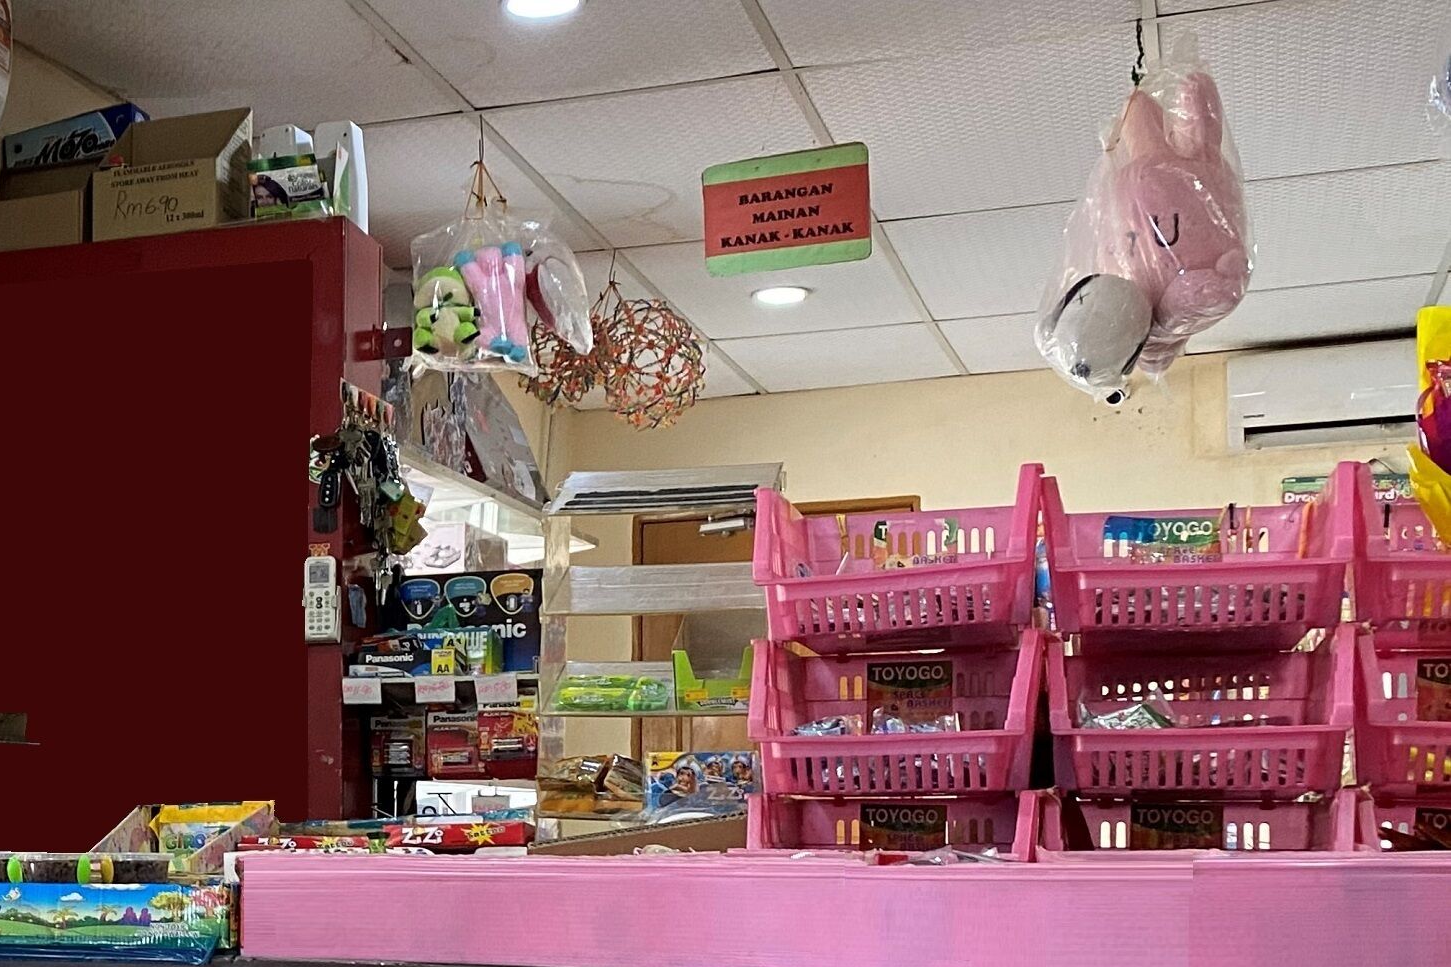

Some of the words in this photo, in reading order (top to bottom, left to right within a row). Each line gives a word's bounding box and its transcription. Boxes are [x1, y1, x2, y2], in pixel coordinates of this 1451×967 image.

[739, 183, 833, 206] BARANGAN
[752, 206, 820, 224] MAINAN
[721, 231, 781, 248] KANAK
[793, 222, 854, 239] KANAK
[365, 653, 415, 664] Panasonic
[436, 664, 450, 674] AA
[872, 665, 944, 682] TOYOGO
[865, 807, 939, 824] TOYOGO
[1137, 808, 1215, 825] TOYOGO
